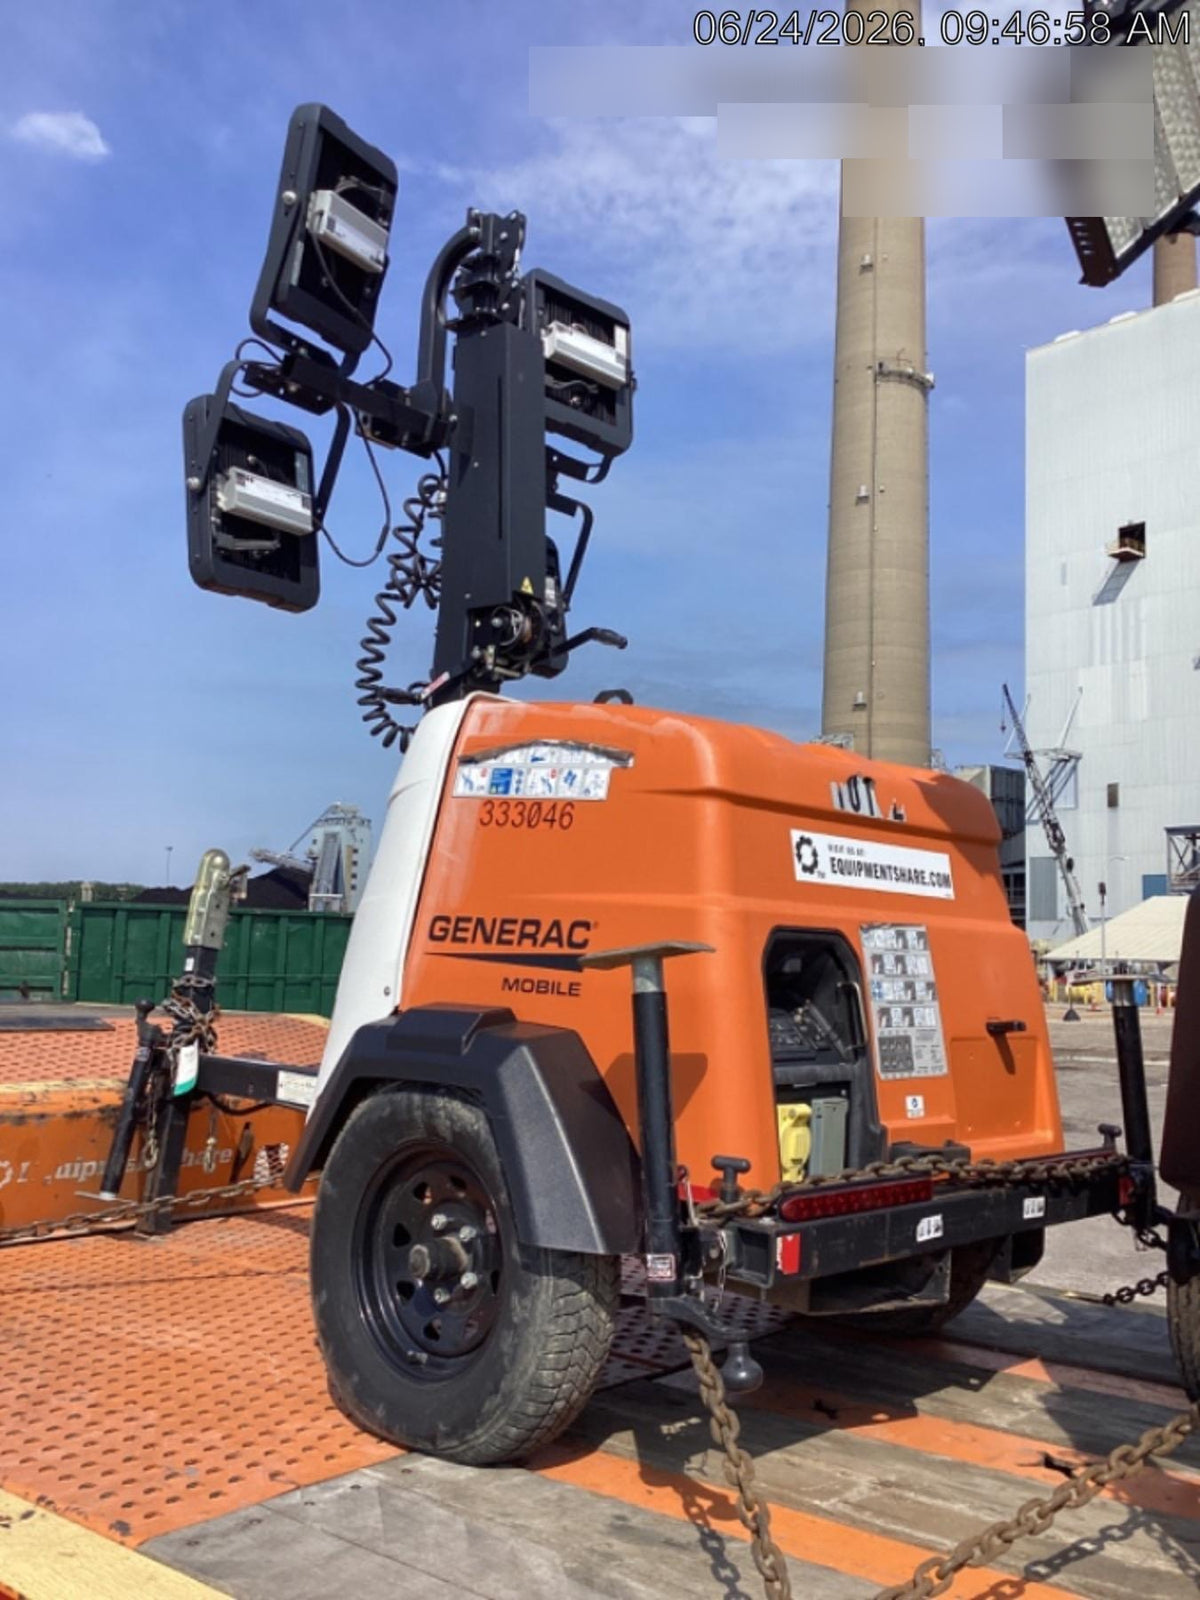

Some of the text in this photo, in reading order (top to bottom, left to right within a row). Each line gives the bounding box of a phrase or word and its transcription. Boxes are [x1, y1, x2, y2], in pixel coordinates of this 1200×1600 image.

[479, 800, 575, 830] 333046
[830, 856, 951, 889] EQUIPMENTSHARE.COM
[428, 914, 592, 950] GENERAC
[501, 977, 582, 997] MOBILE
